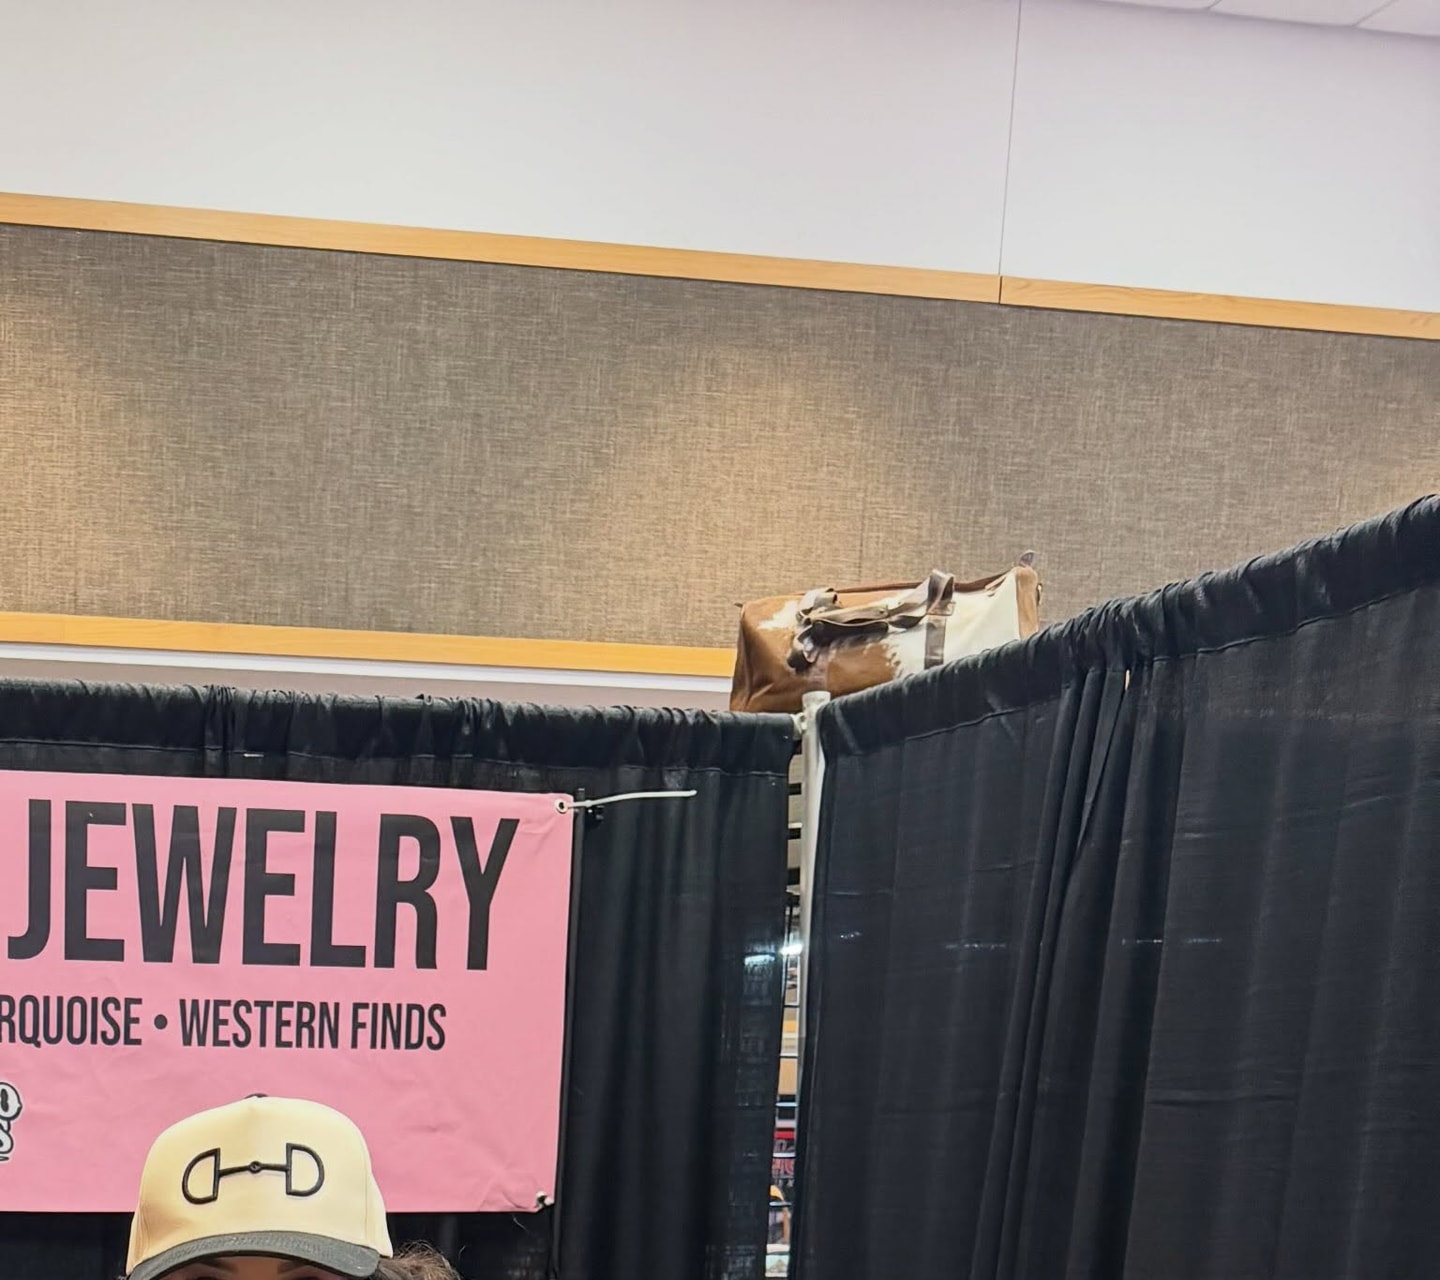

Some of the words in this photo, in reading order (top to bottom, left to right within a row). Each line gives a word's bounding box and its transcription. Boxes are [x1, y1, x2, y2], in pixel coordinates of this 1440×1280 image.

[6, 797, 521, 971] JEWELRY
[179, 998, 340, 1049] WESTERN
[350, 1002, 447, 1051] FINDS
